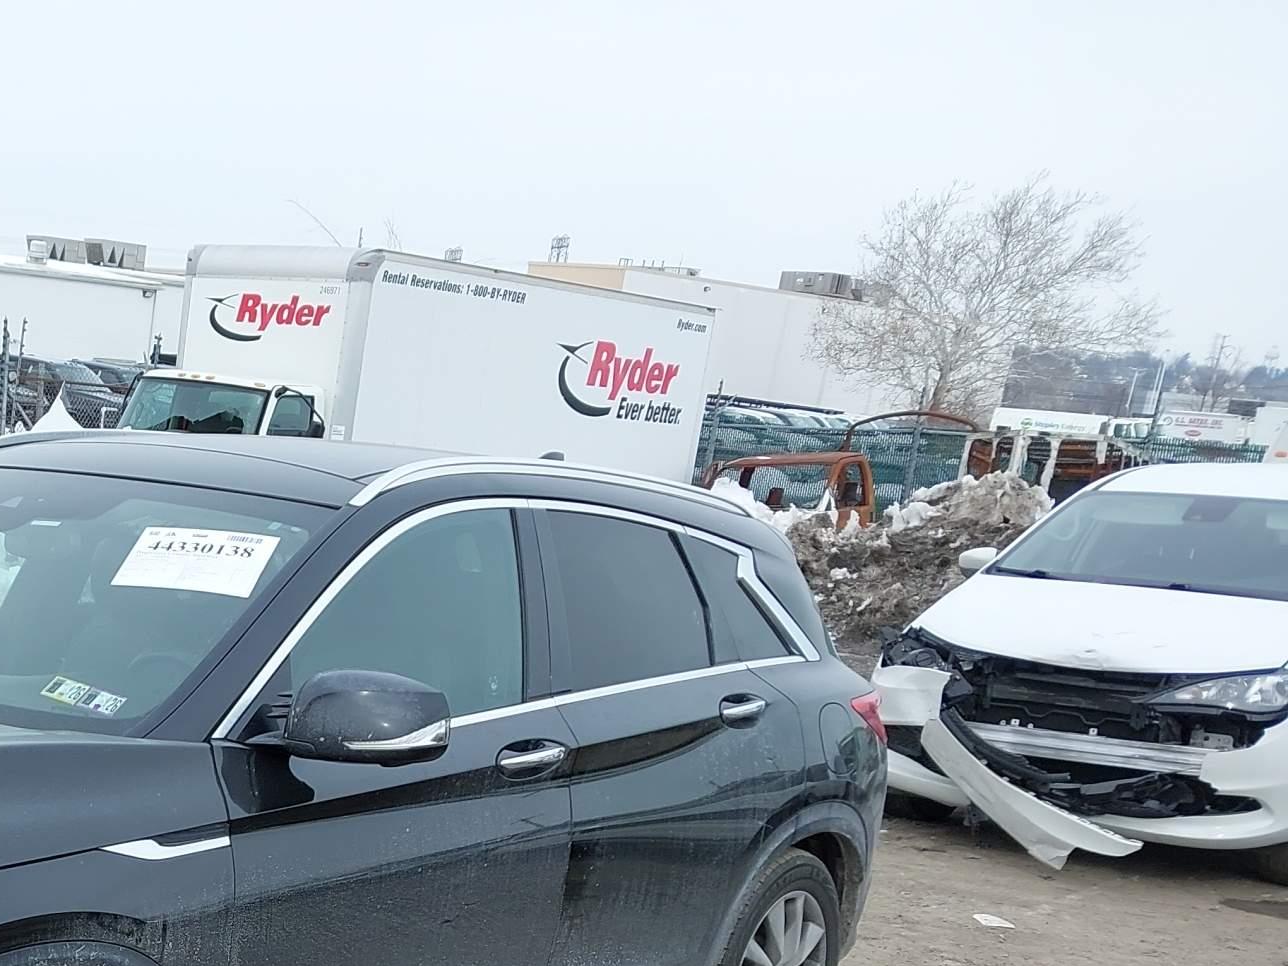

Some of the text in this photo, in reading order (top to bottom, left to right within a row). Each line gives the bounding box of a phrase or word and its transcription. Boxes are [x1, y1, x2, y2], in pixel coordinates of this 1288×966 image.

[382, 270, 527, 304] Rental Reservations: 1-800-BY-RYDER
[236, 293, 331, 331] Ryder
[676, 318, 707, 334] Ryder.com
[586, 340, 680, 400] Ryder
[616, 397, 683, 425] Ever better.
[147, 540, 255, 559] 44330138
